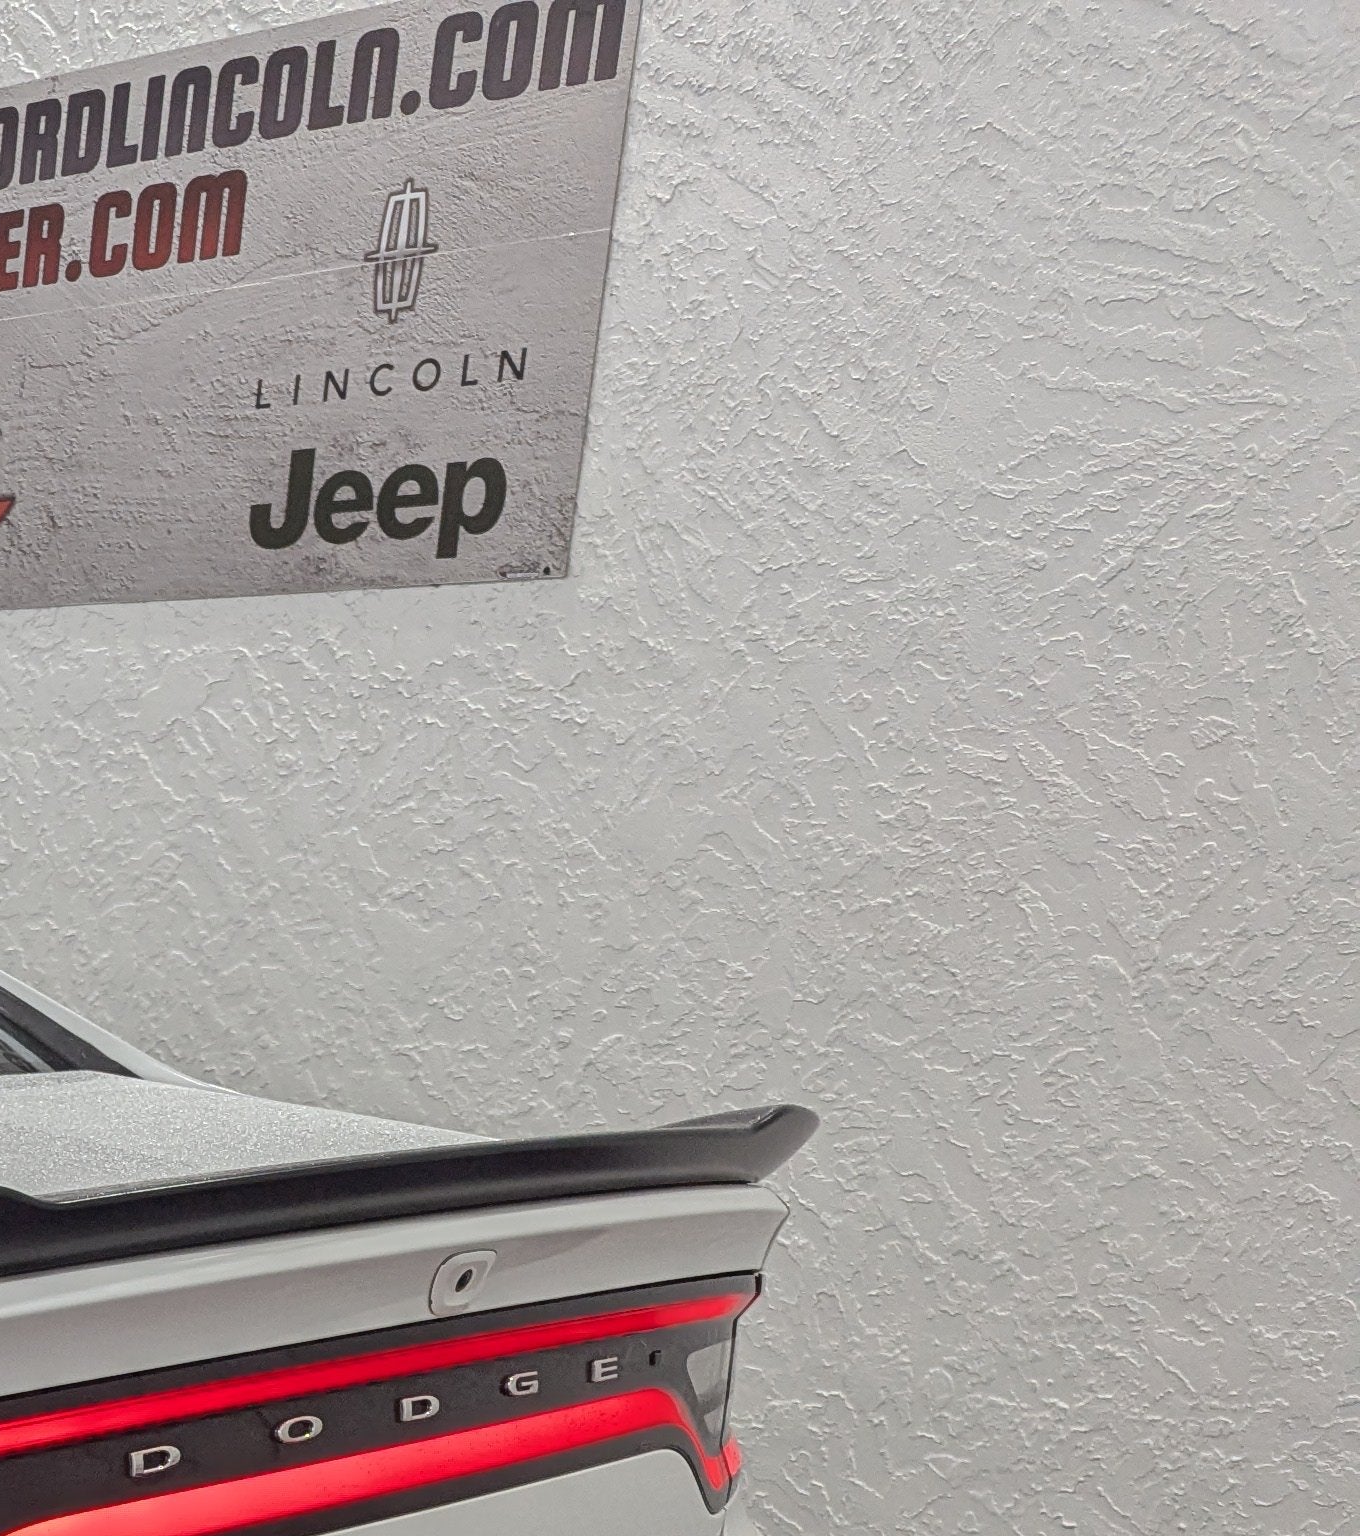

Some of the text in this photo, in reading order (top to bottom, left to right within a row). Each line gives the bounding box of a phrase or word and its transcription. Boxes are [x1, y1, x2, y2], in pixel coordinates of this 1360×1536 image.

[253, 348, 528, 410] LINCOLN
[249, 448, 507, 559] Jeep
[128, 1354, 621, 1479] DODGE
